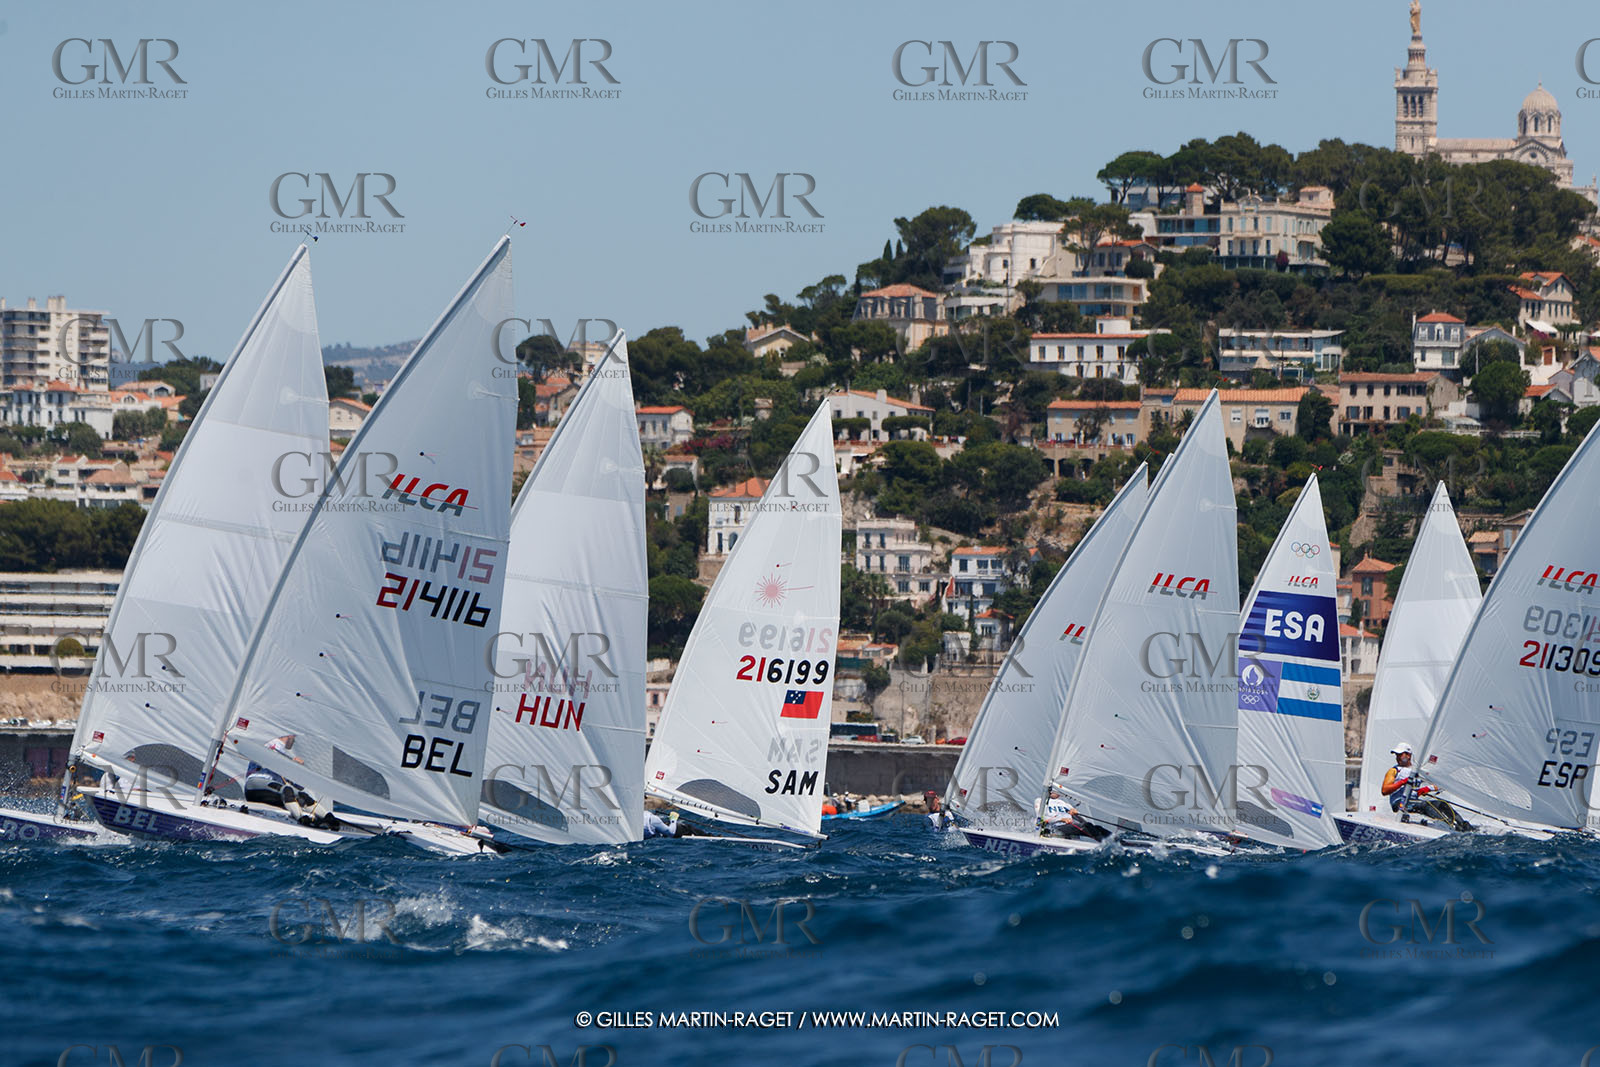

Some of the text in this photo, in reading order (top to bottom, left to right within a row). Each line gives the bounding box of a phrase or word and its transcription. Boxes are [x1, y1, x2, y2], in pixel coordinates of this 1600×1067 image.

[382, 473, 470, 517] ILCA
[1147, 572, 1211, 600] ILCA
[1288, 575, 1319, 589] ILCA
[1537, 565, 1598, 594] ILCA
[376, 572, 491, 628] 214116
[1264, 609, 1325, 643] ESA
[736, 655, 829, 685] 216199
[515, 693, 586, 732] HUN
[401, 733, 473, 778] BEL
[765, 769, 819, 796] SAM
[1537, 760, 1589, 789] ESP
[113, 807, 159, 832] BEL
